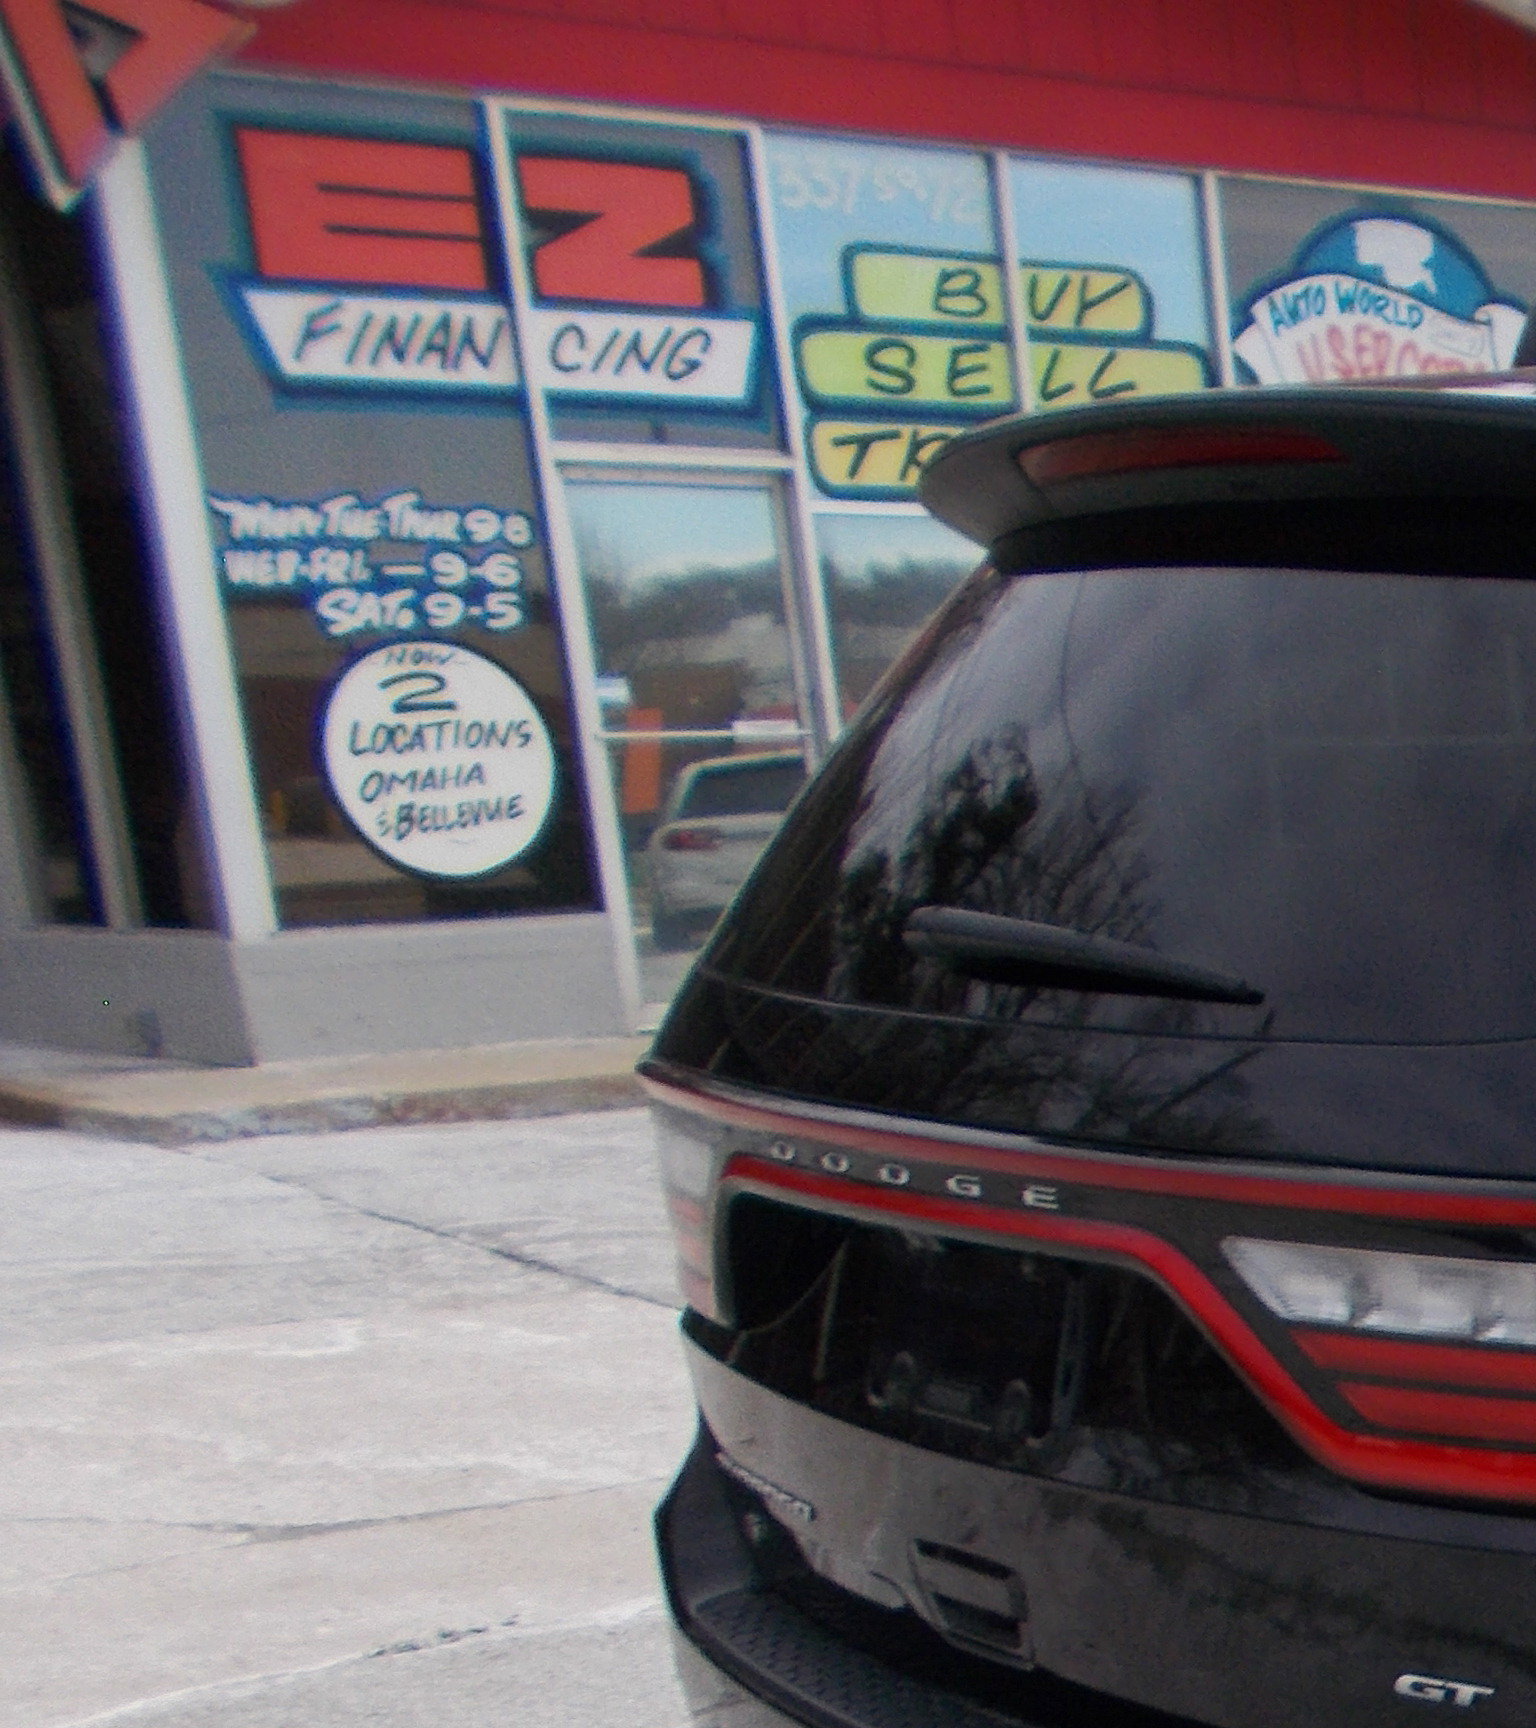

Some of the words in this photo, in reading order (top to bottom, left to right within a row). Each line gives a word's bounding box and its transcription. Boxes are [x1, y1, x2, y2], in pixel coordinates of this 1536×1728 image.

[235, 126, 705, 307] EZ
[930, 267, 1131, 328] BUY
[1267, 283, 1327, 337] AUTO
[1334, 280, 1425, 331] WORLD
[292, 300, 712, 382] FINANCING
[864, 336, 1137, 402] SELL
[831, 428, 952, 482] TR
[430, 551, 522, 587] 9-6
[423, 590, 523, 630] 9-5
[376, 669, 458, 715] 2
[348, 718, 534, 757] LOCATIONS
[358, 761, 487, 804] OMAHA
[394, 793, 526, 841] BELLEVUE
[769, 1140, 1061, 1210] DODGE
[1394, 1674, 1496, 1708] GT
